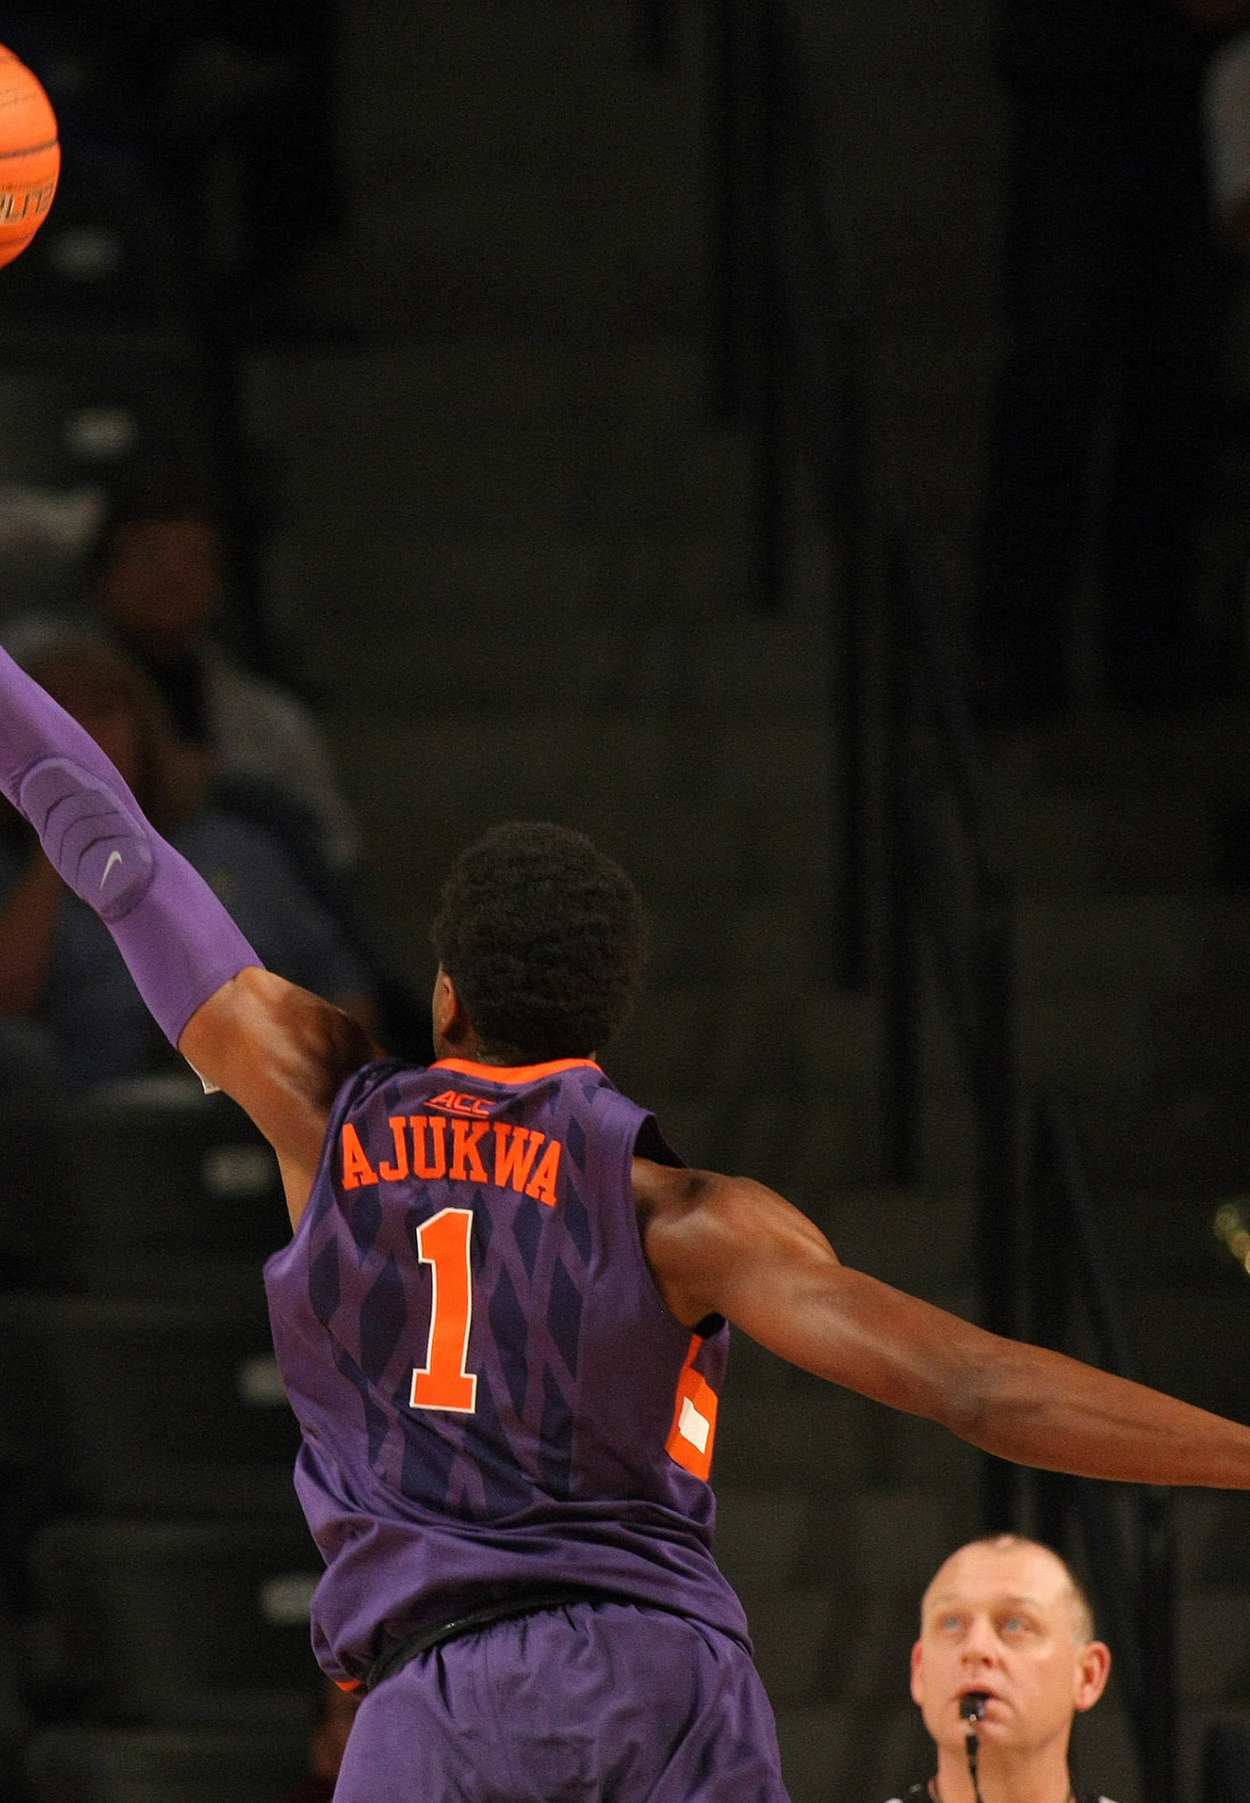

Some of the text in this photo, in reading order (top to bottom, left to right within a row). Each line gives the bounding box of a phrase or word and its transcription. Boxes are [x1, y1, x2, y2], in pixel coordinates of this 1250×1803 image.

[427, 1090, 496, 1117] ACC
[342, 1115, 562, 1207] AJUKWA
[409, 1207, 477, 1414] 1
